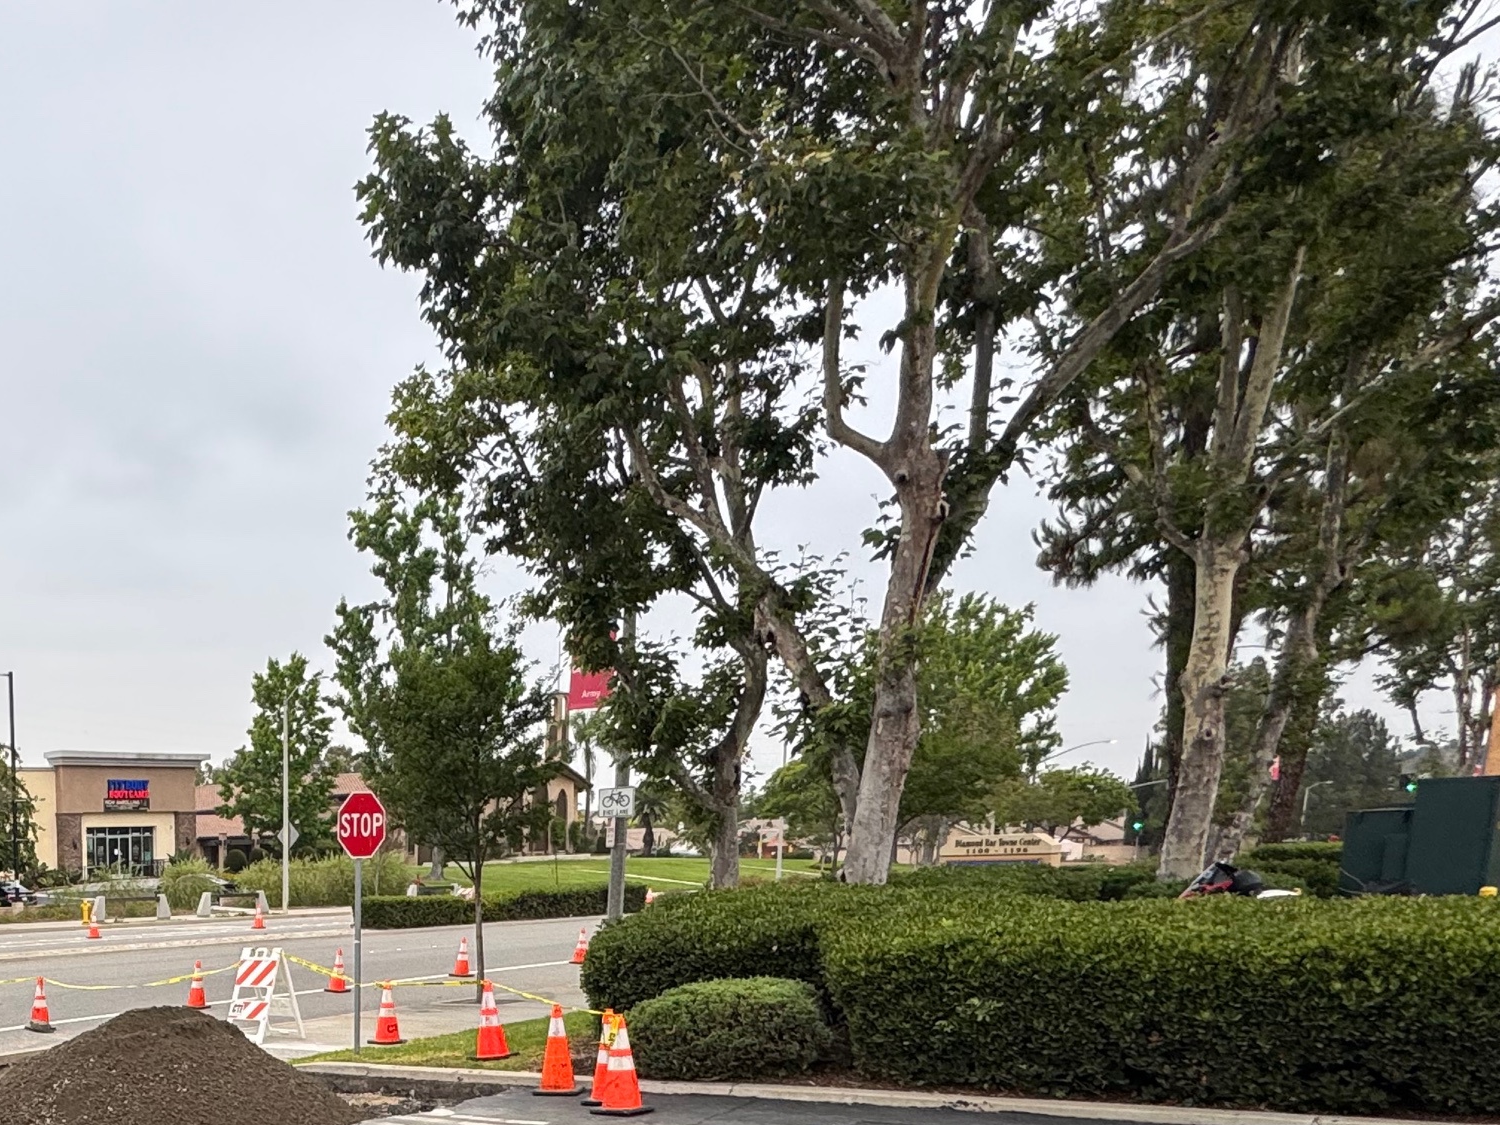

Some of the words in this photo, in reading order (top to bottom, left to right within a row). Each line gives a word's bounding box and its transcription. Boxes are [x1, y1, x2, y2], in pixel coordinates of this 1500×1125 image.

[581, 689, 601, 699] Army
[340, 812, 383, 838] STOP
[955, 839, 983, 848] Diamond
[985, 839, 997, 847] Bar
[999, 838, 1017, 847] Towne
[1019, 838, 1042, 846] Center
